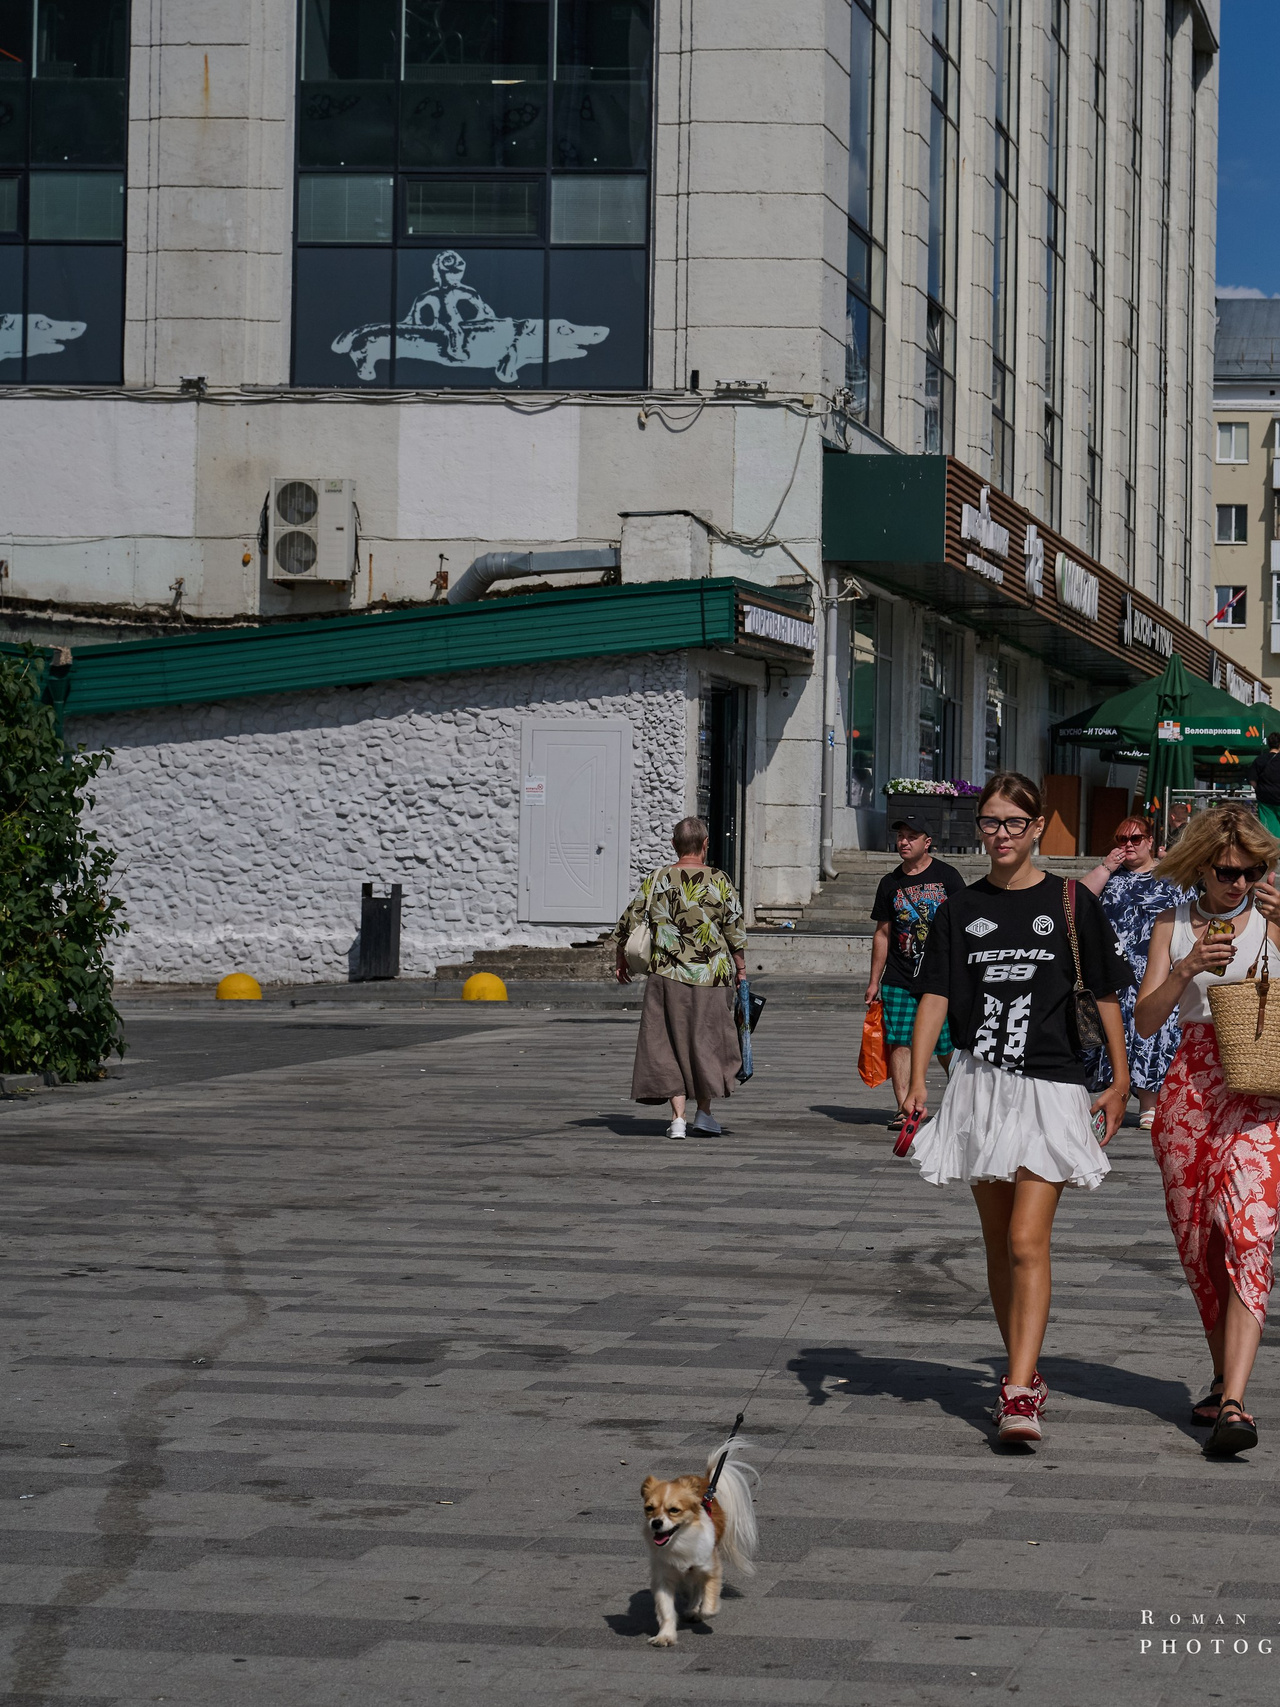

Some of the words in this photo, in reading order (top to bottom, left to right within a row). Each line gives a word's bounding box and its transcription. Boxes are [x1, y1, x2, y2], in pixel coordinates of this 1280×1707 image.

[1094, 728, 1118, 736] ТОЧКА
[1184, 727, 1241, 736] Велопарковка
[967, 948, 1056, 964] ПЕРМЬ
[982, 963, 1038, 983] 59
